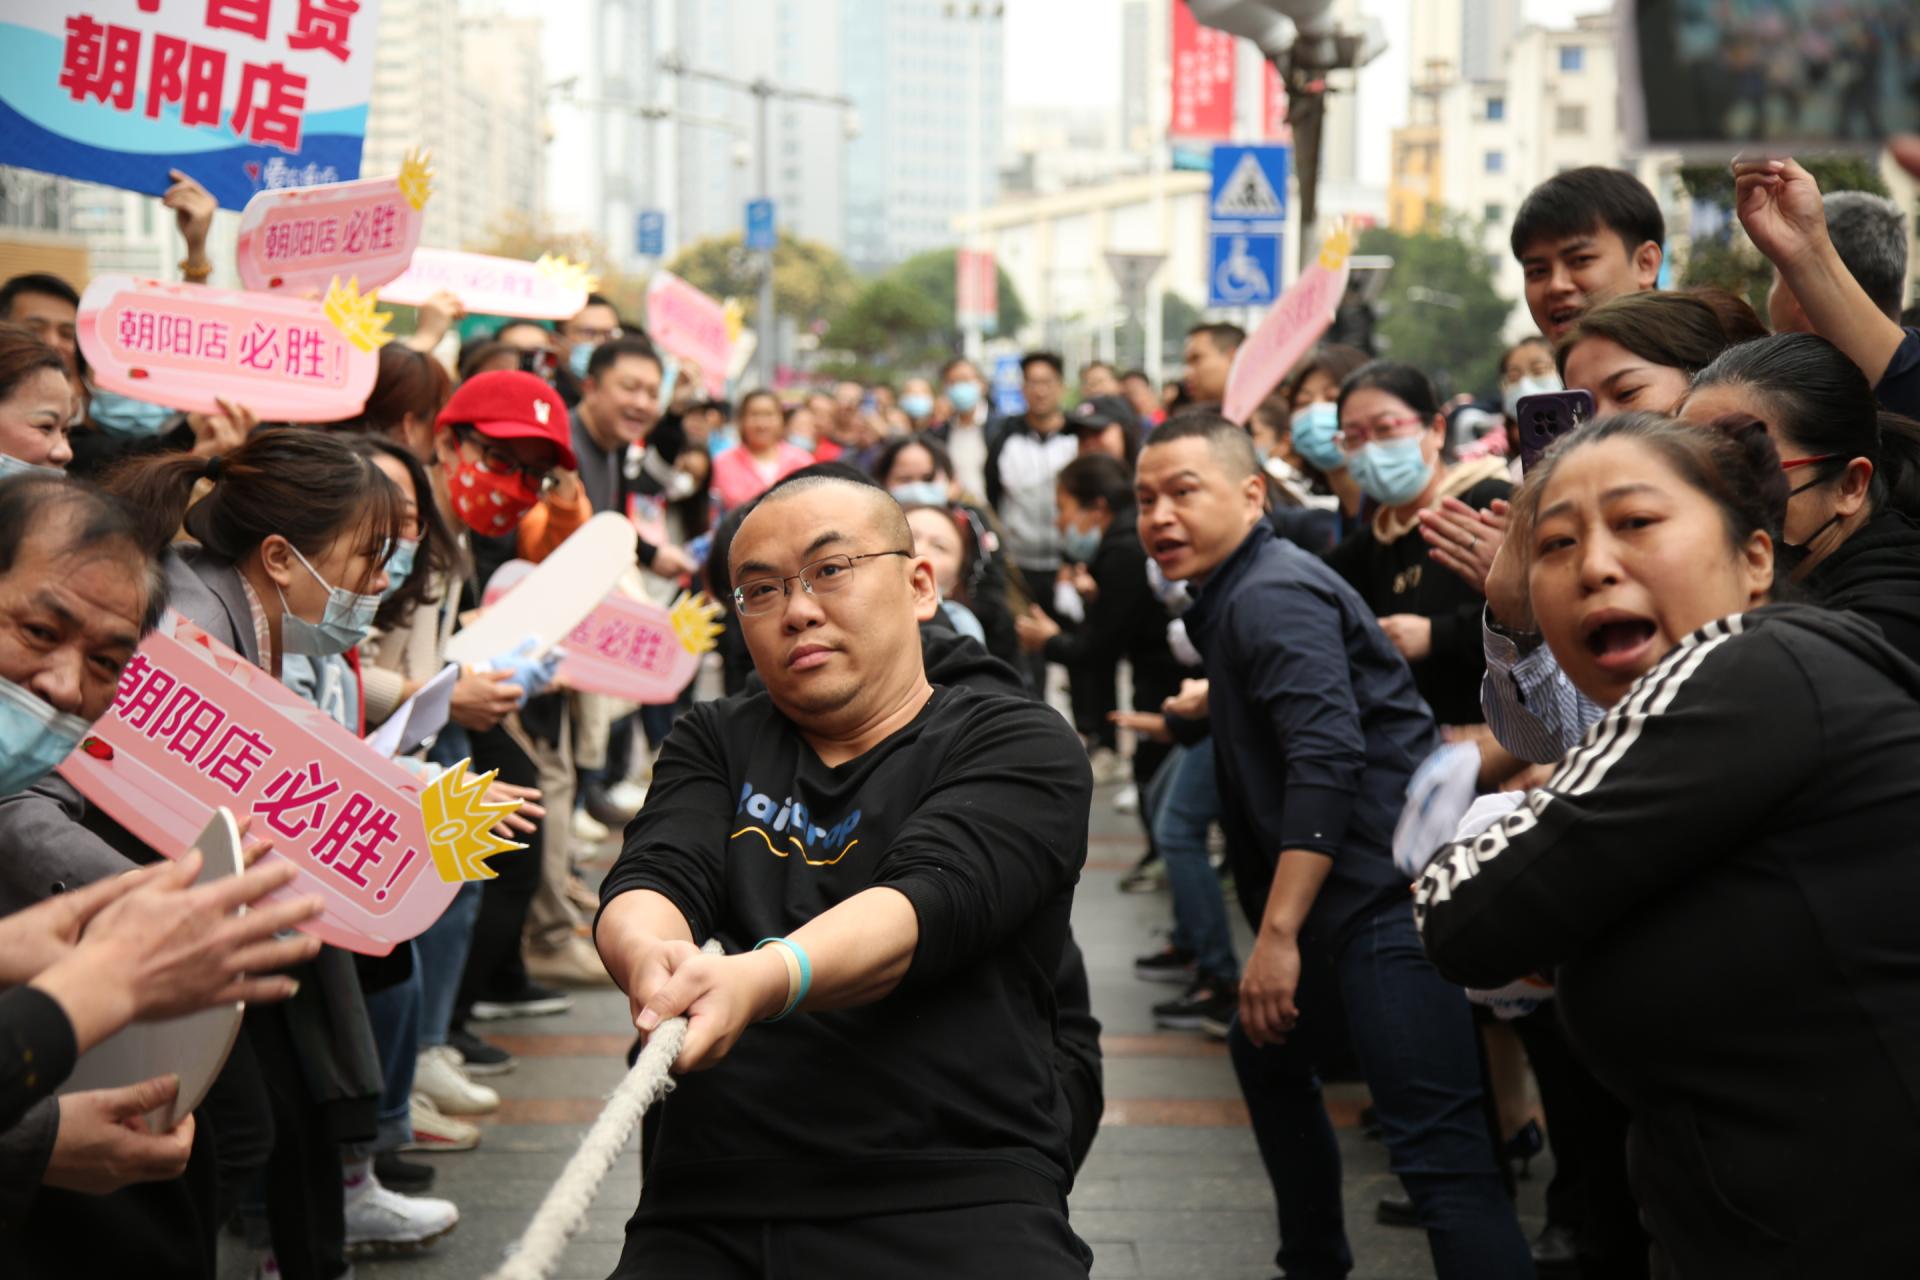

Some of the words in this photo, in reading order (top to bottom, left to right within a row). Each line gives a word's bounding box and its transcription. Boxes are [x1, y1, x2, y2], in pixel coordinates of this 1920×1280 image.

[59, 13, 308, 154] 朝阳店
[265, 217, 338, 259] 朝阳店
[119, 310, 229, 360] 朝阳店
[239, 321, 342, 381] 必胜!
[113, 655, 273, 794] 朝阳店
[253, 761, 416, 902] 必胜!
